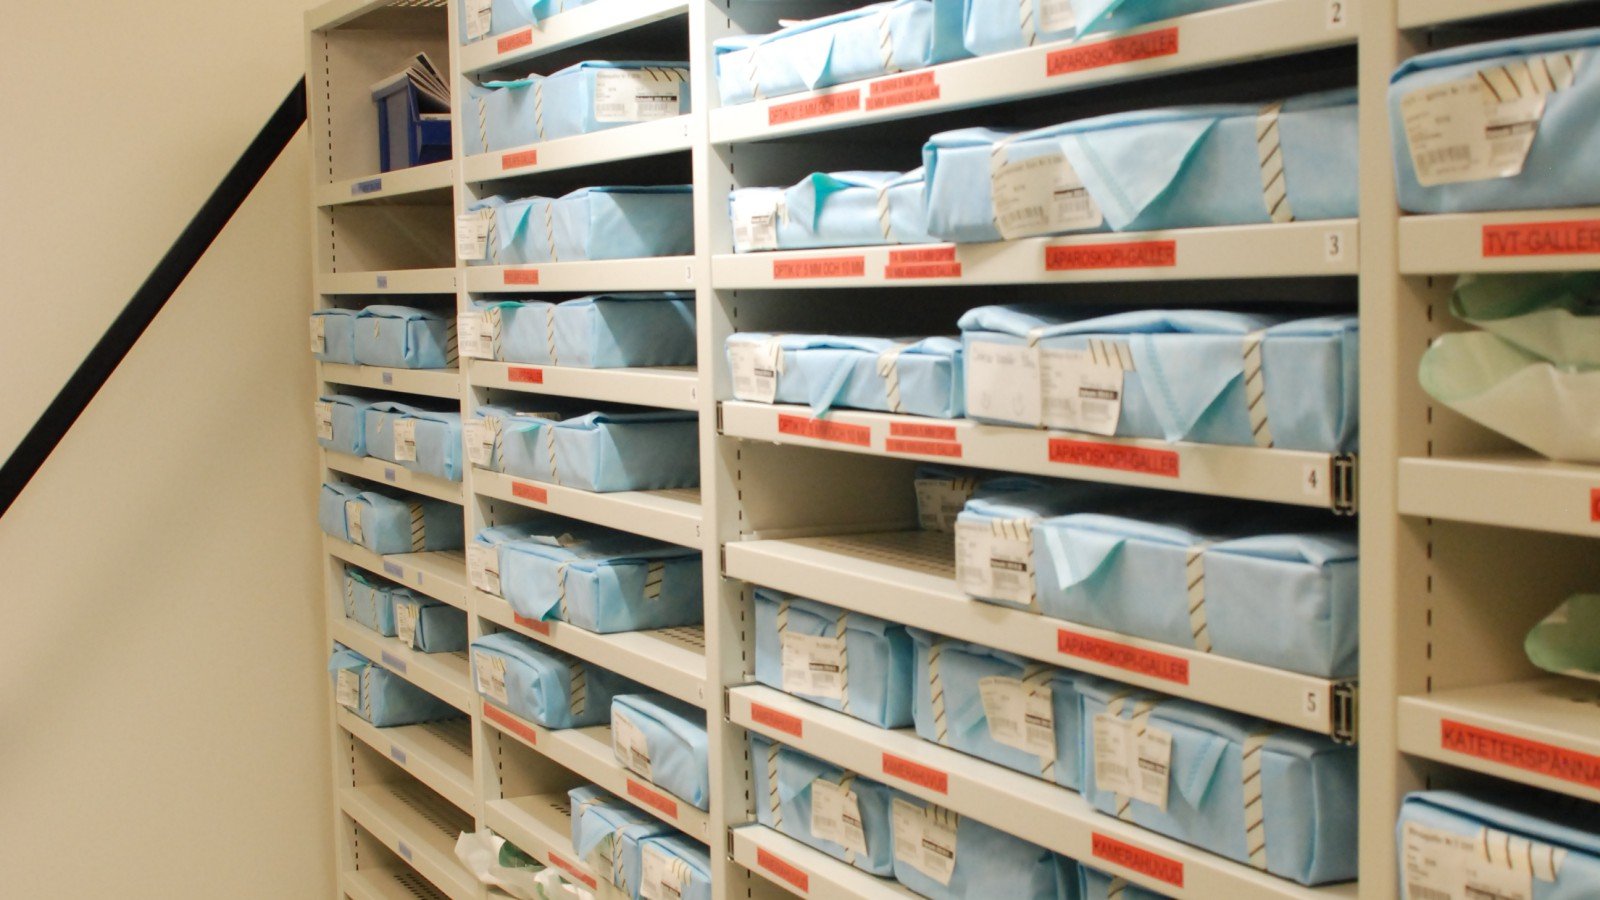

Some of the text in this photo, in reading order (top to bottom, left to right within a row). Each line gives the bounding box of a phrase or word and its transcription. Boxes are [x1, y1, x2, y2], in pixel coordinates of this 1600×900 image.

[1332, 3, 1341, 23] 2
[1330, 235, 1339, 256] 3
[1308, 469, 1317, 488] 4
[1307, 692, 1316, 712] 5
